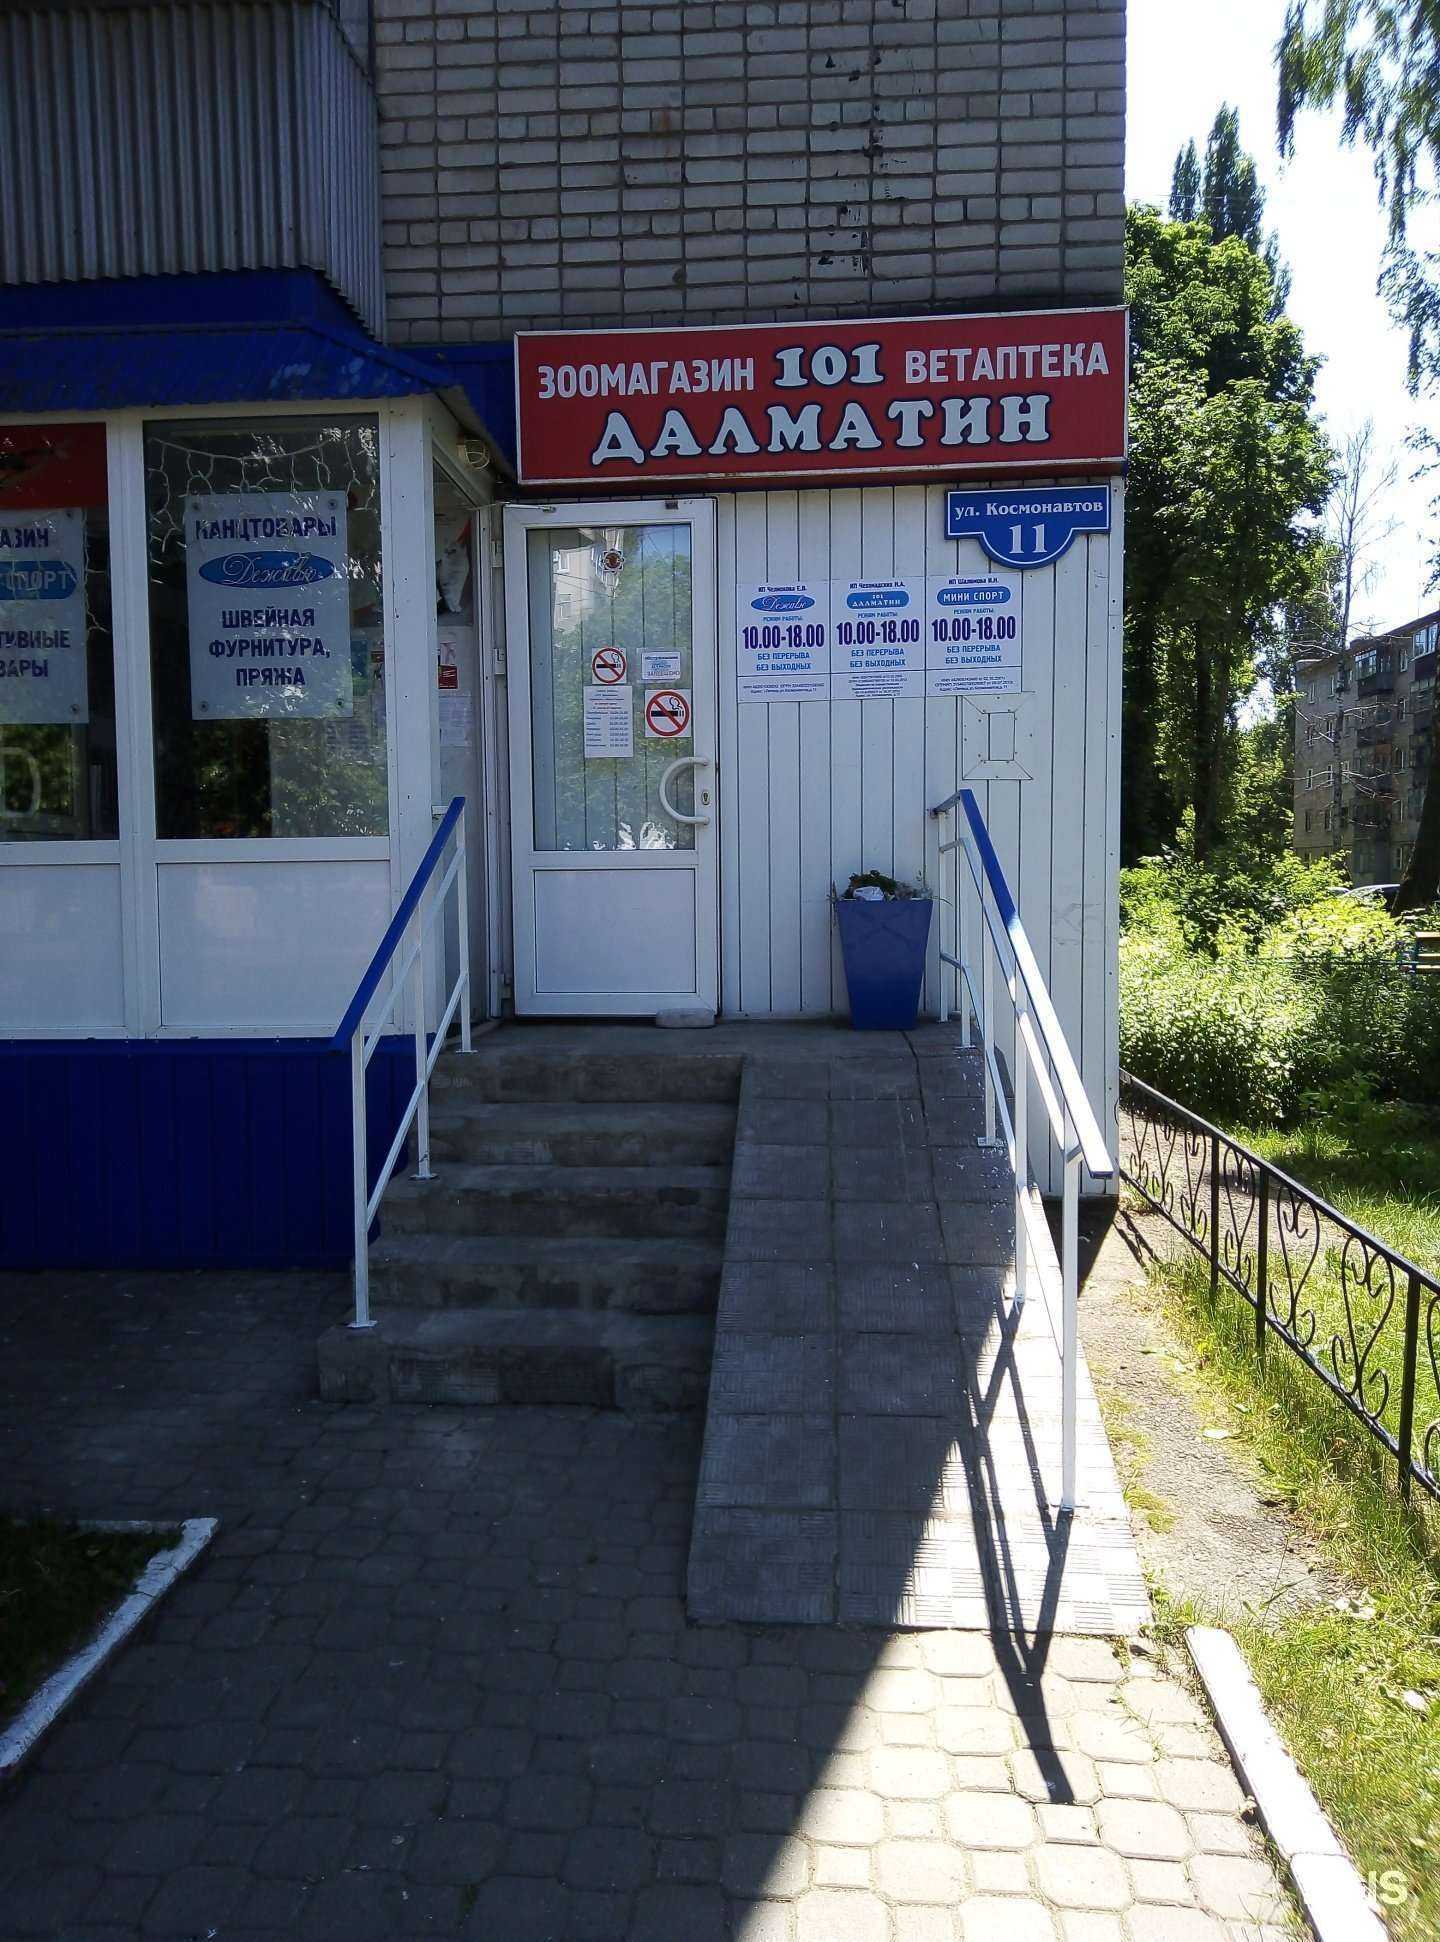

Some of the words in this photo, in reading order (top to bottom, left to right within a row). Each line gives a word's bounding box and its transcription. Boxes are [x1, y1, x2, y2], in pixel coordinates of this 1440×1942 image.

[538, 357, 755, 399] ЗООМАГАЗИН
[773, 343, 885, 388] 101
[904, 341, 1110, 385] ВЕТАПТЕКА
[592, 394, 1051, 465] ДАЛМАТИН
[954, 506, 980, 520] ул.
[986, 501, 1104, 516] Космонавтов
[196, 516, 337, 541] КАНЦТОВАРЫ
[1008, 523, 1048, 554] 11
[943, 592, 970, 602] МИНИ
[973, 591, 1004, 601] СПОРТ
[222, 606, 315, 628] ШВЕЙНАЯ
[742, 623, 825, 649] 10.00-18.00
[836, 618, 920, 645] 10.00-18.00
[931, 616, 1016, 641] 10.00-18.00
[208, 637, 331, 658] ФУРНИТУРА,
[772, 652, 810, 660] ПЕРЕРЫВА
[851, 649, 864, 657] БЕЗ
[866, 648, 905, 656] ПЕРЕРЫВА
[962, 644, 1001, 652] ПЕРЕРЫВА
[850, 660, 863, 668] БЕЗ
[865, 659, 906, 668] ВЫХОДНЫХ
[945, 656, 958, 664] БЕЗ
[961, 655, 1002, 664] ВЫХОДНЫХ
[236, 667, 306, 686] ПРЯЖА
